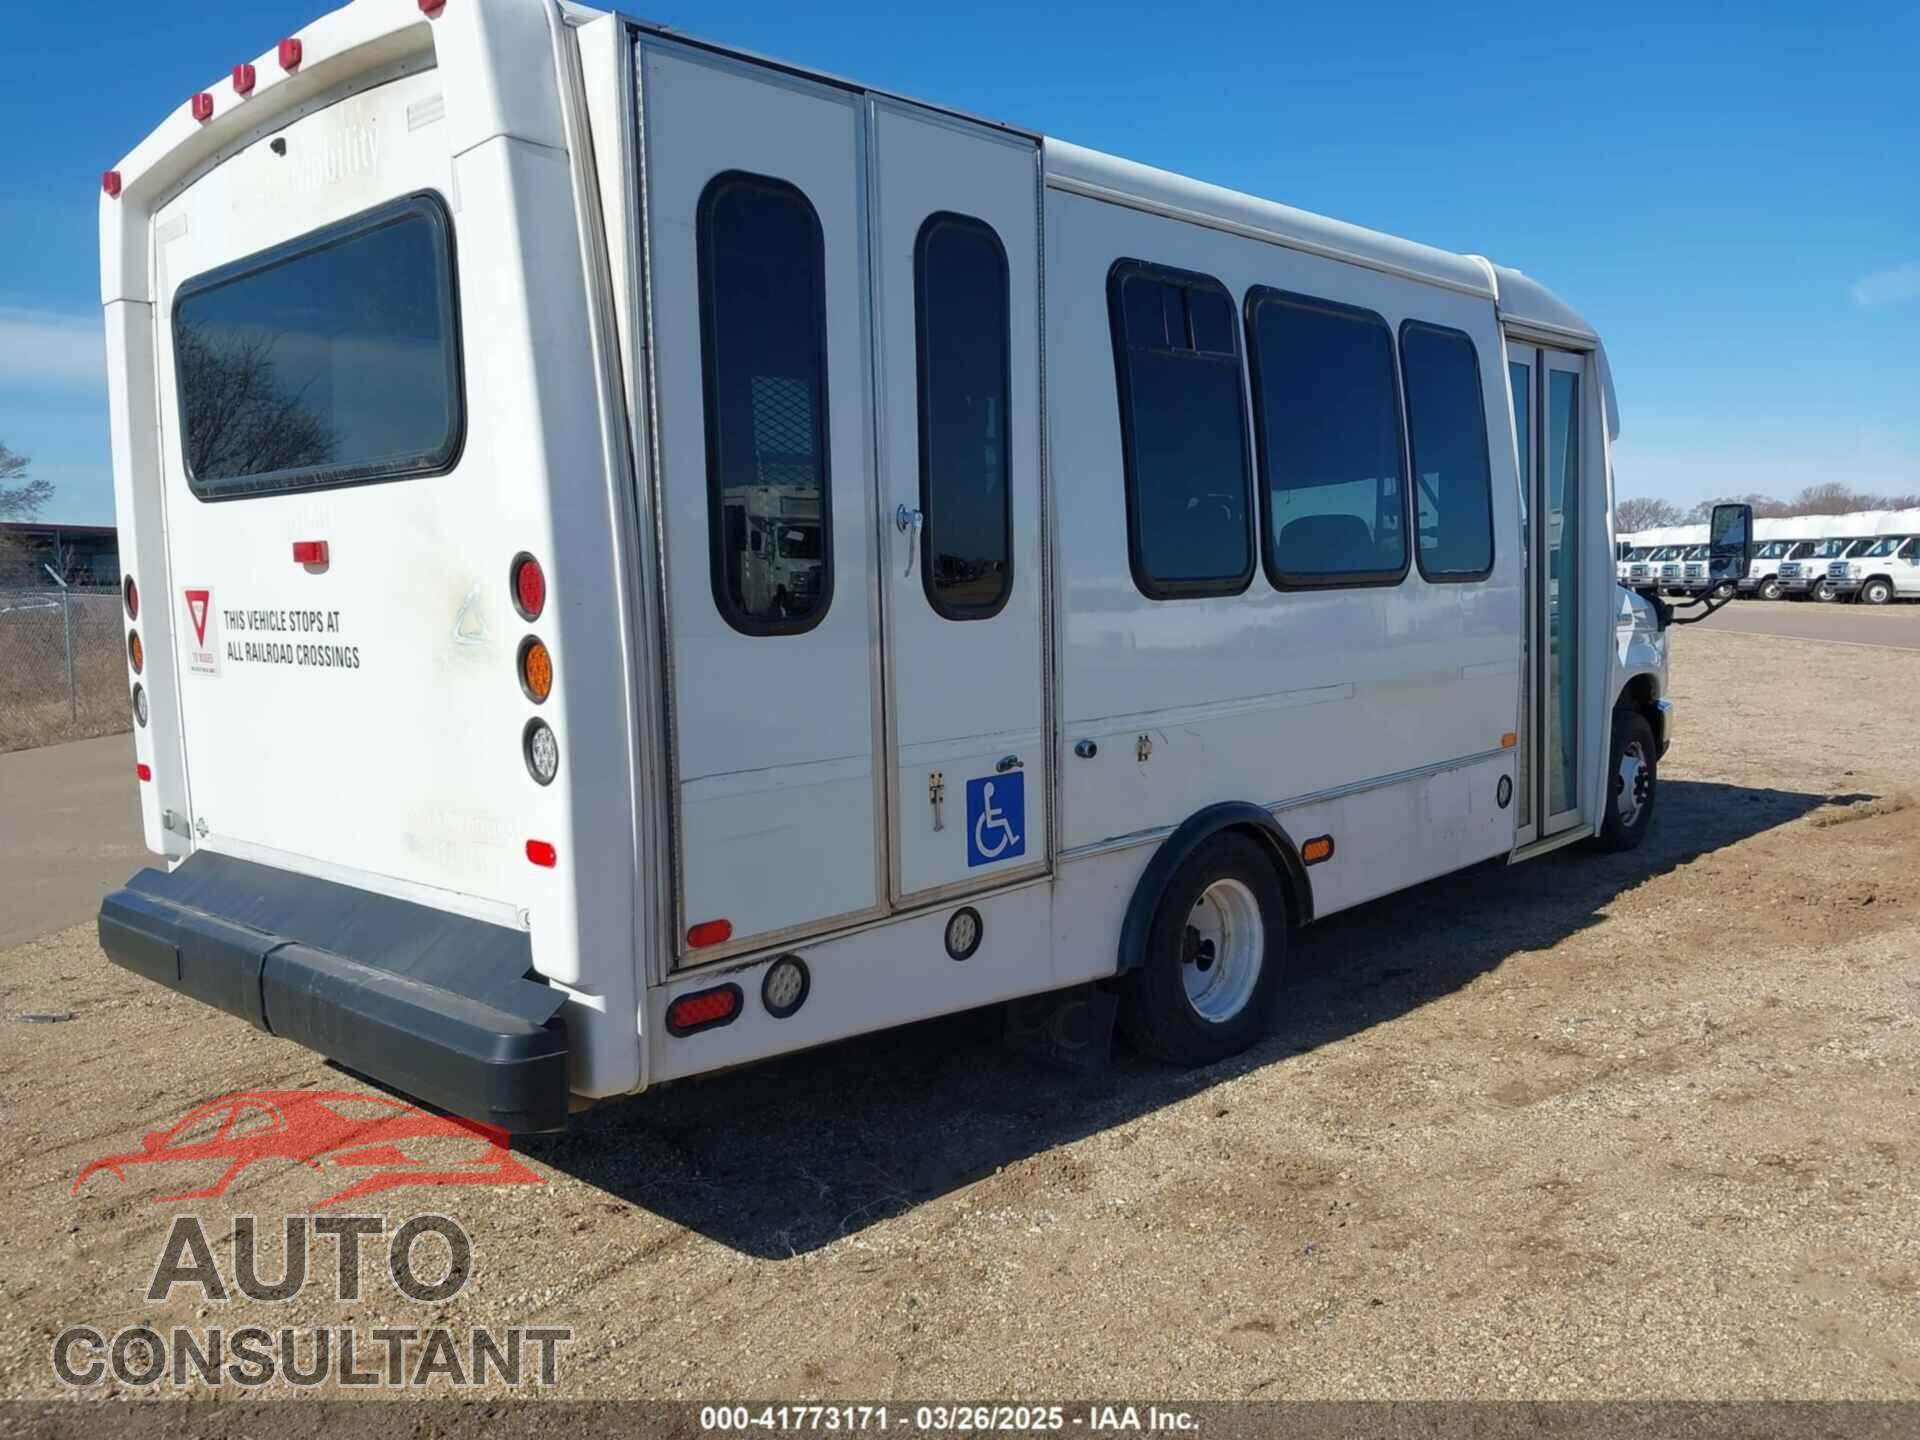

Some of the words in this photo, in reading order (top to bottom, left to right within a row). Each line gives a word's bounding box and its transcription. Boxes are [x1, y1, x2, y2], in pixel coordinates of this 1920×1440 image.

[224, 610, 246, 630] THIS
[247, 611, 287, 631] VEHICLE
[289, 611, 324, 632] STOPS
[327, 611, 340, 632] AT
[227, 642, 244, 661] ALL
[245, 642, 293, 664] RAILROAD
[296, 644, 360, 669] CROSSINGS
